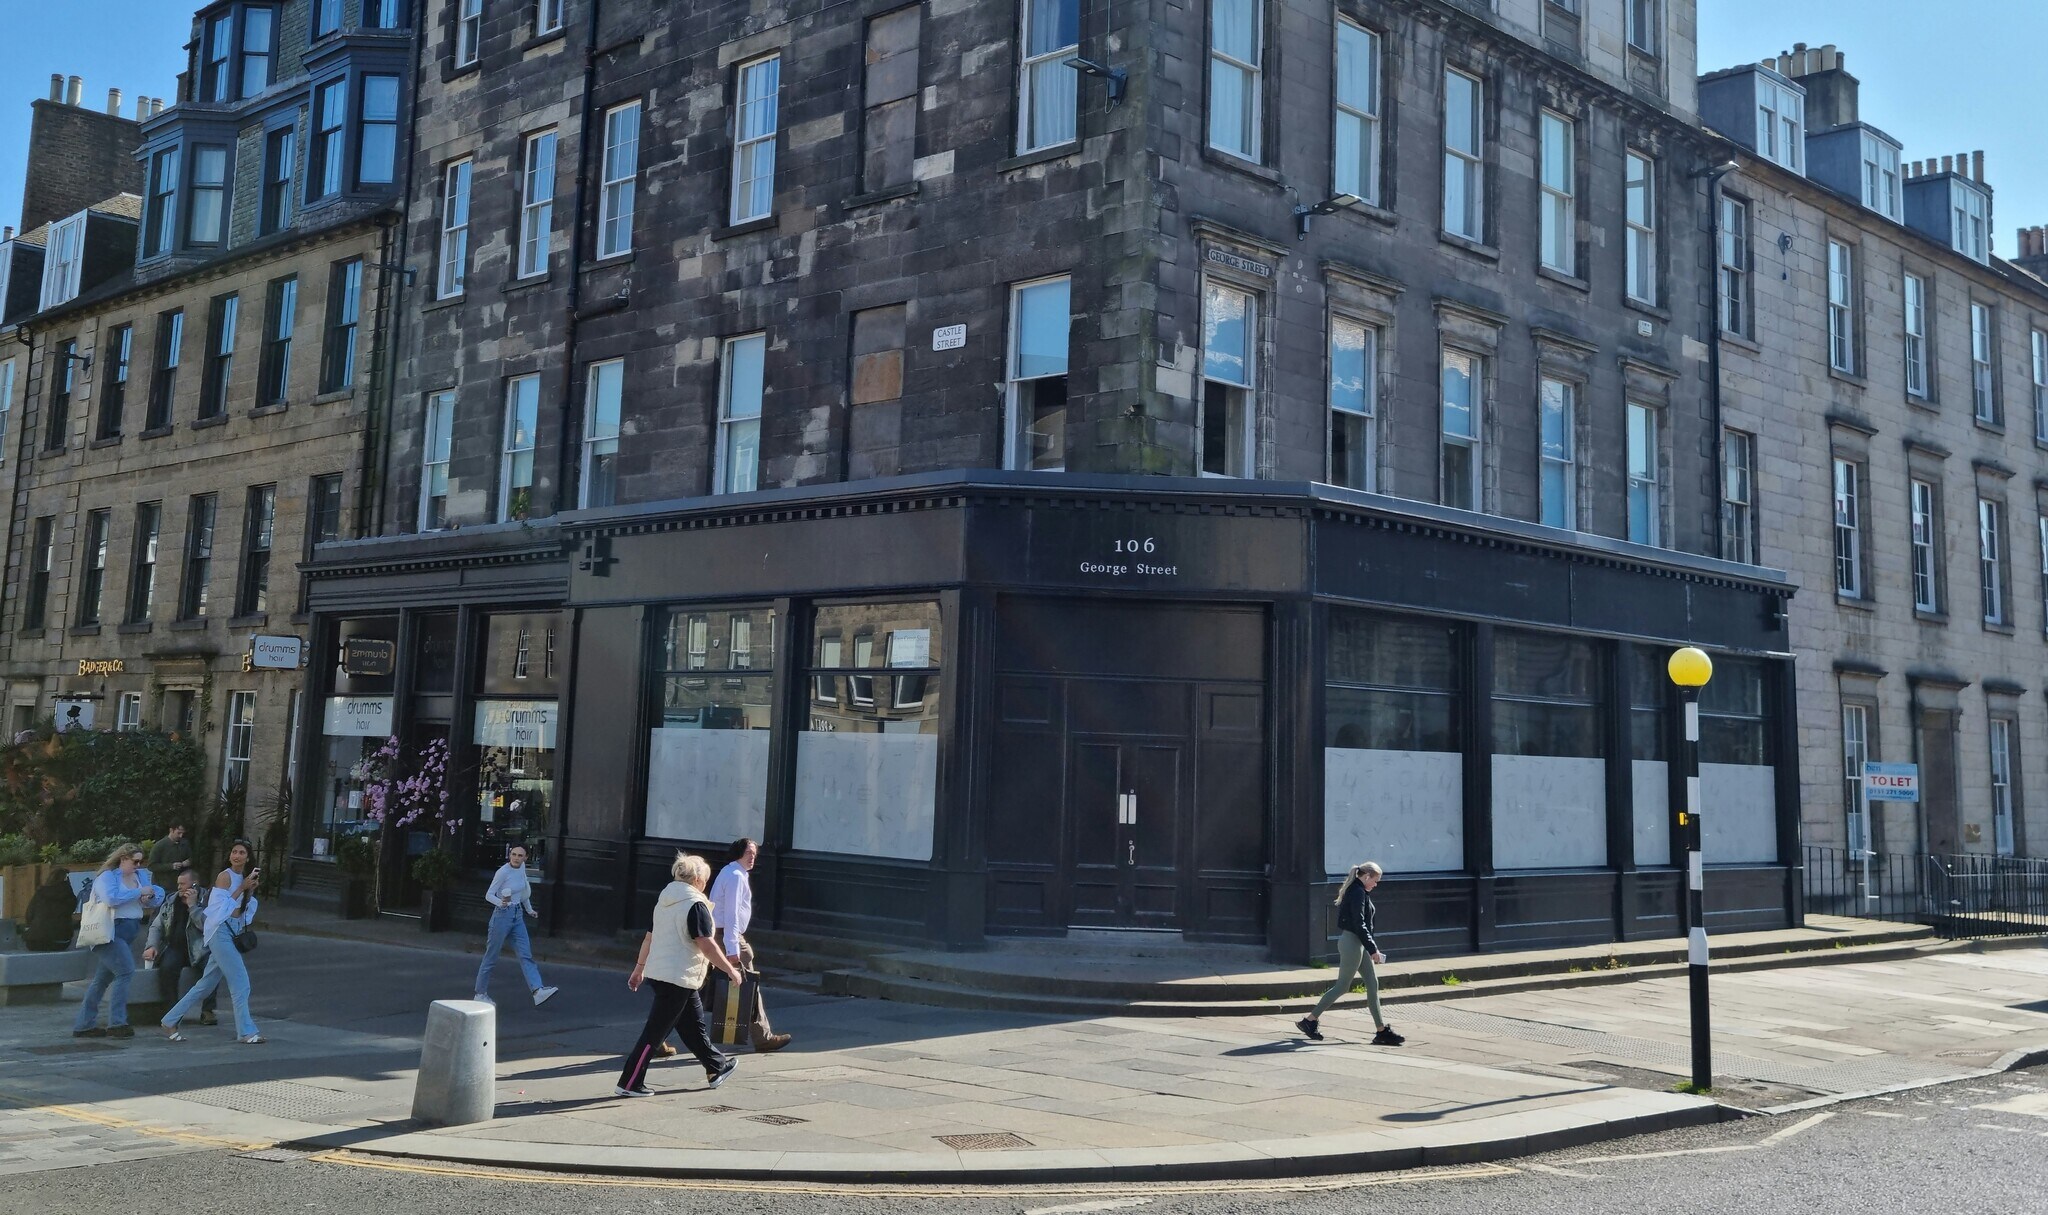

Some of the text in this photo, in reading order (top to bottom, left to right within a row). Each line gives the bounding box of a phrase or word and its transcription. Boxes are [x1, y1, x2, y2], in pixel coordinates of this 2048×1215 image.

[1210, 250, 1269, 276] GEORGE STREET
[937, 326, 962, 338] CASTLE
[937, 338, 962, 349] STREET
[1114, 537, 1156, 554] 106
[1080, 561, 1178, 576] George Street
[258, 641, 297, 654] drumms
[268, 654, 285, 662] hair
[347, 700, 382, 715] drumms
[355, 718, 371, 730] hair
[515, 727, 533, 741] hair
[1871, 776, 1911, 787] TO LET
